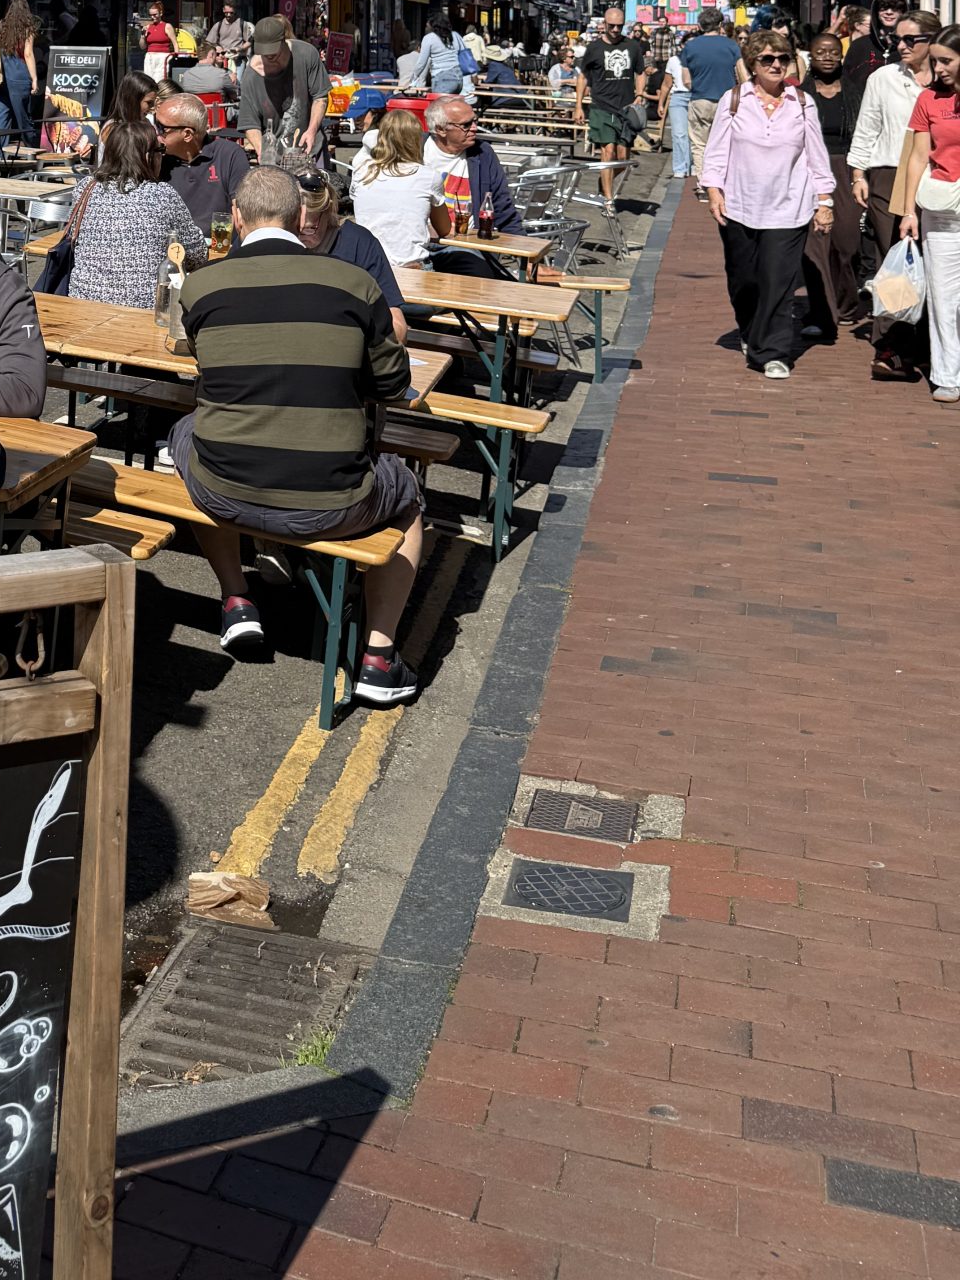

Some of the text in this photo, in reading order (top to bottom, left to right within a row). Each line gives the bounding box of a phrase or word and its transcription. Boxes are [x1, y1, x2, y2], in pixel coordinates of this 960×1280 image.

[60, 56, 75, 64] THE
[77, 56, 96, 65] DELI
[52, 73, 99, 87] K-DOGS
[170, 245, 181, 260] 7
